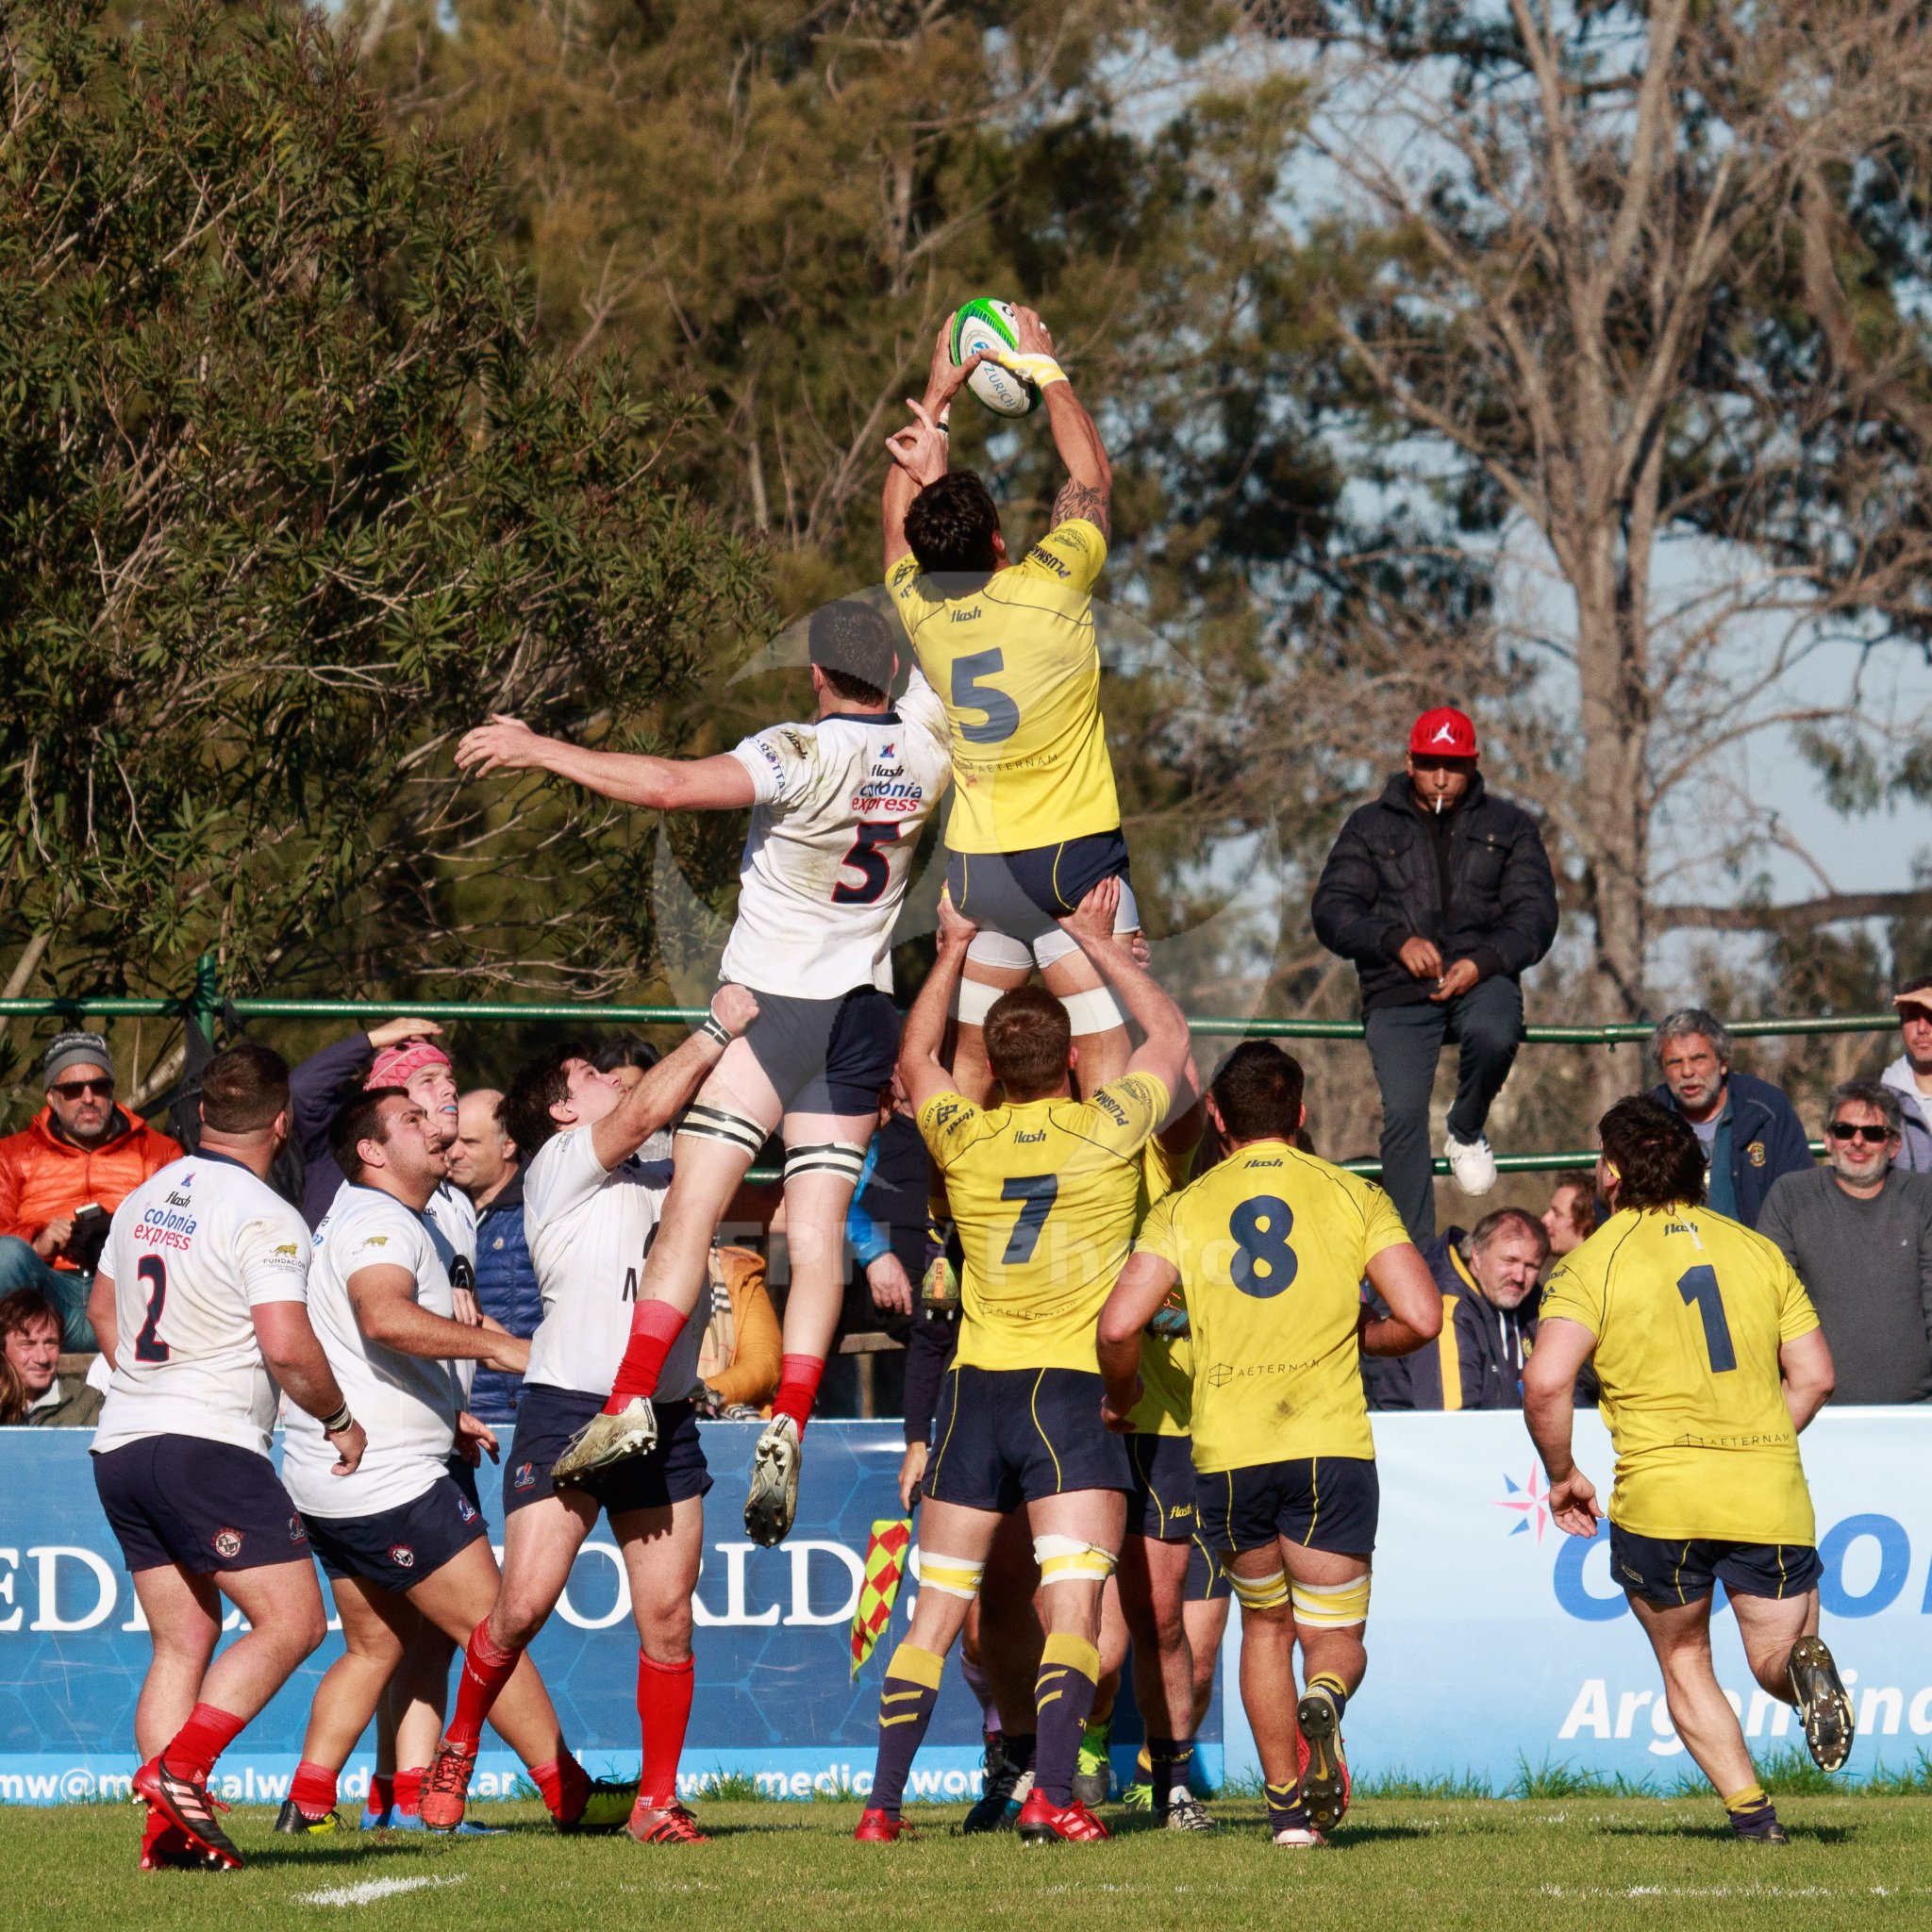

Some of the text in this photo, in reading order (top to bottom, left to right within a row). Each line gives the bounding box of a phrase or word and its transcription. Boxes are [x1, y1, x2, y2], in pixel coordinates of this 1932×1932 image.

[984, 365, 1014, 408] ZURICH
[1030, 544, 1072, 579] PLUSMA
[951, 606, 982, 623] flash
[951, 646, 1021, 744] 5
[871, 764, 905, 777] flash
[977, 753, 1058, 774] AETERNAM
[859, 781, 923, 799] colonia
[851, 797, 921, 815] express
[831, 820, 902, 905] 5
[1092, 1087, 1130, 1127] PLUSMA
[1013, 1128, 1047, 1144] flash
[1243, 1158, 1284, 1170] flash
[164, 1191, 192, 1208] flash
[143, 1208, 198, 1236] colonia
[1001, 1174, 1058, 1265] 7
[1663, 1222, 1699, 1237] flash
[134, 1224, 192, 1252] express
[1229, 1194, 1298, 1299] 8
[135, 1254, 170, 1362] 2
[1676, 1264, 1738, 1374] 1
